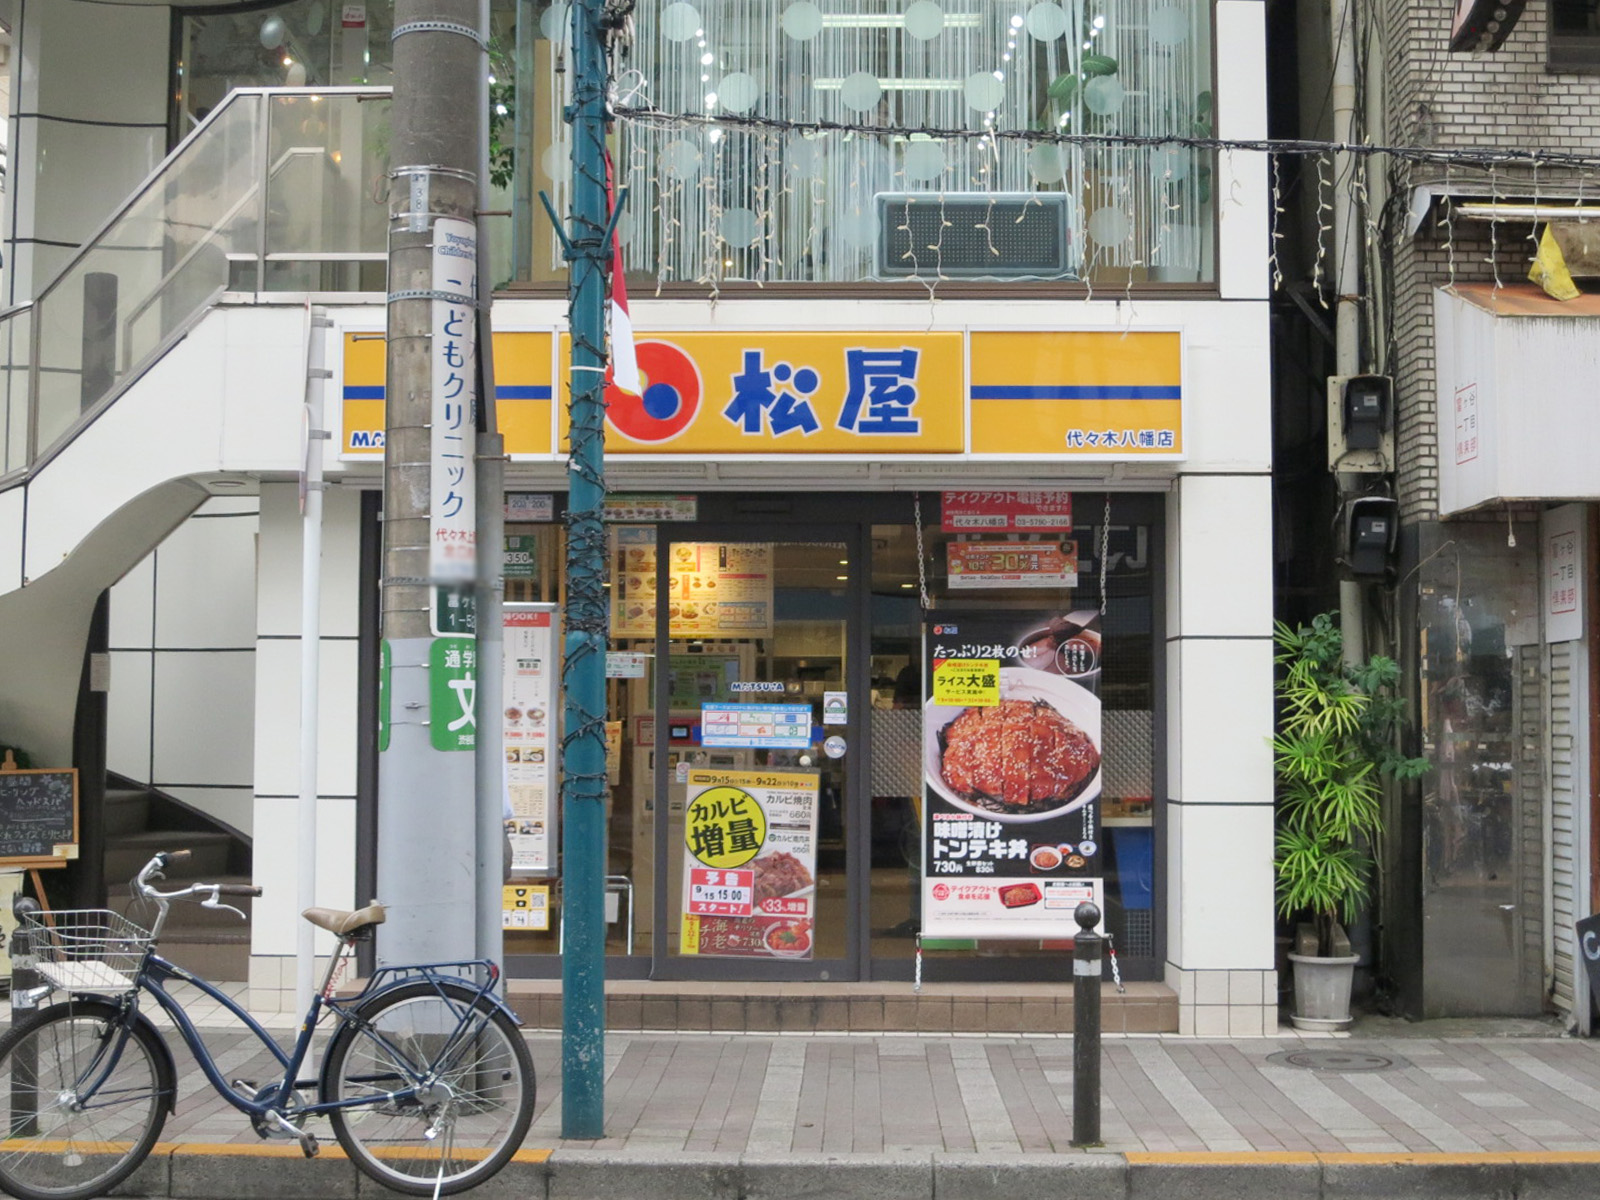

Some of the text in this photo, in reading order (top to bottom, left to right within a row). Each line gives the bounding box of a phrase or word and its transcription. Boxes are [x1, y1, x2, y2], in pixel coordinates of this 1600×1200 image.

[442, 279, 465, 518] こどもクリニック
[723, 347, 922, 437] 松屋
[1066, 429, 1174, 448] 代々木八幡店
[932, 644, 1038, 659] たっぷり2枚のせ!
[937, 673, 996, 688] ライス大盛
[691, 794, 749, 824] カルビ
[690, 817, 761, 859] 増量
[933, 839, 1028, 860] トンテキ丼
[933, 861, 964, 873] 730円
[698, 902, 744, 914] スタート!
